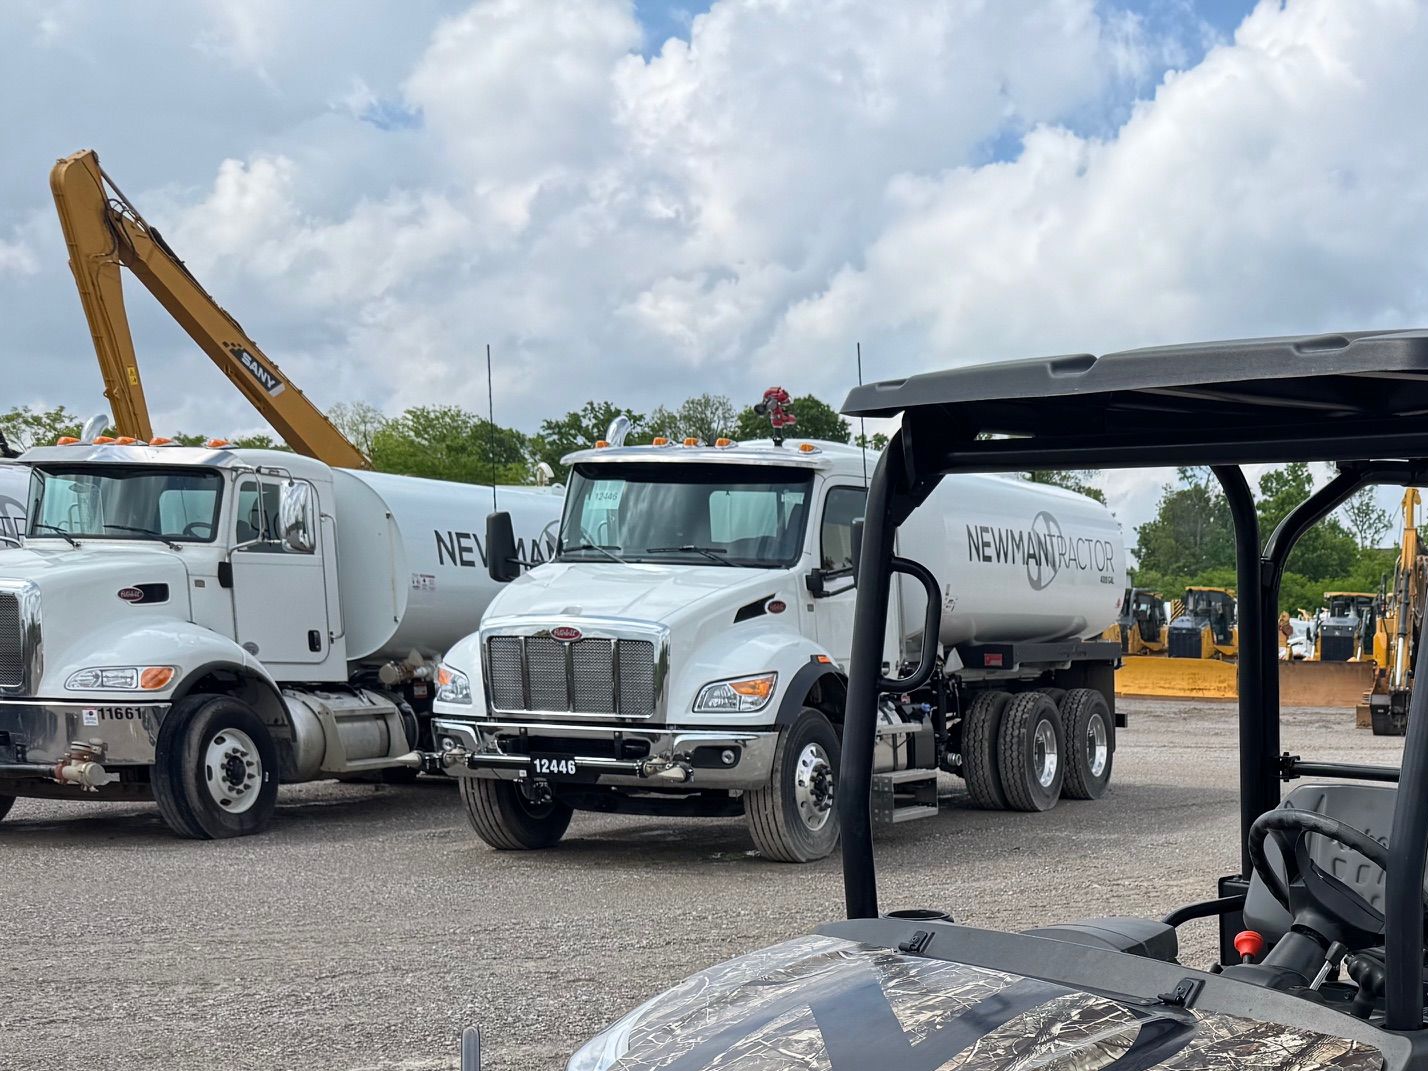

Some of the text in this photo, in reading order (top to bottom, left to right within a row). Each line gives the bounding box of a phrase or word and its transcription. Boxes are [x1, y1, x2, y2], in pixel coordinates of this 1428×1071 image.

[241, 352, 276, 388] SANY
[98, 707, 142, 720] 11661
[533, 758, 576, 775] 12446
